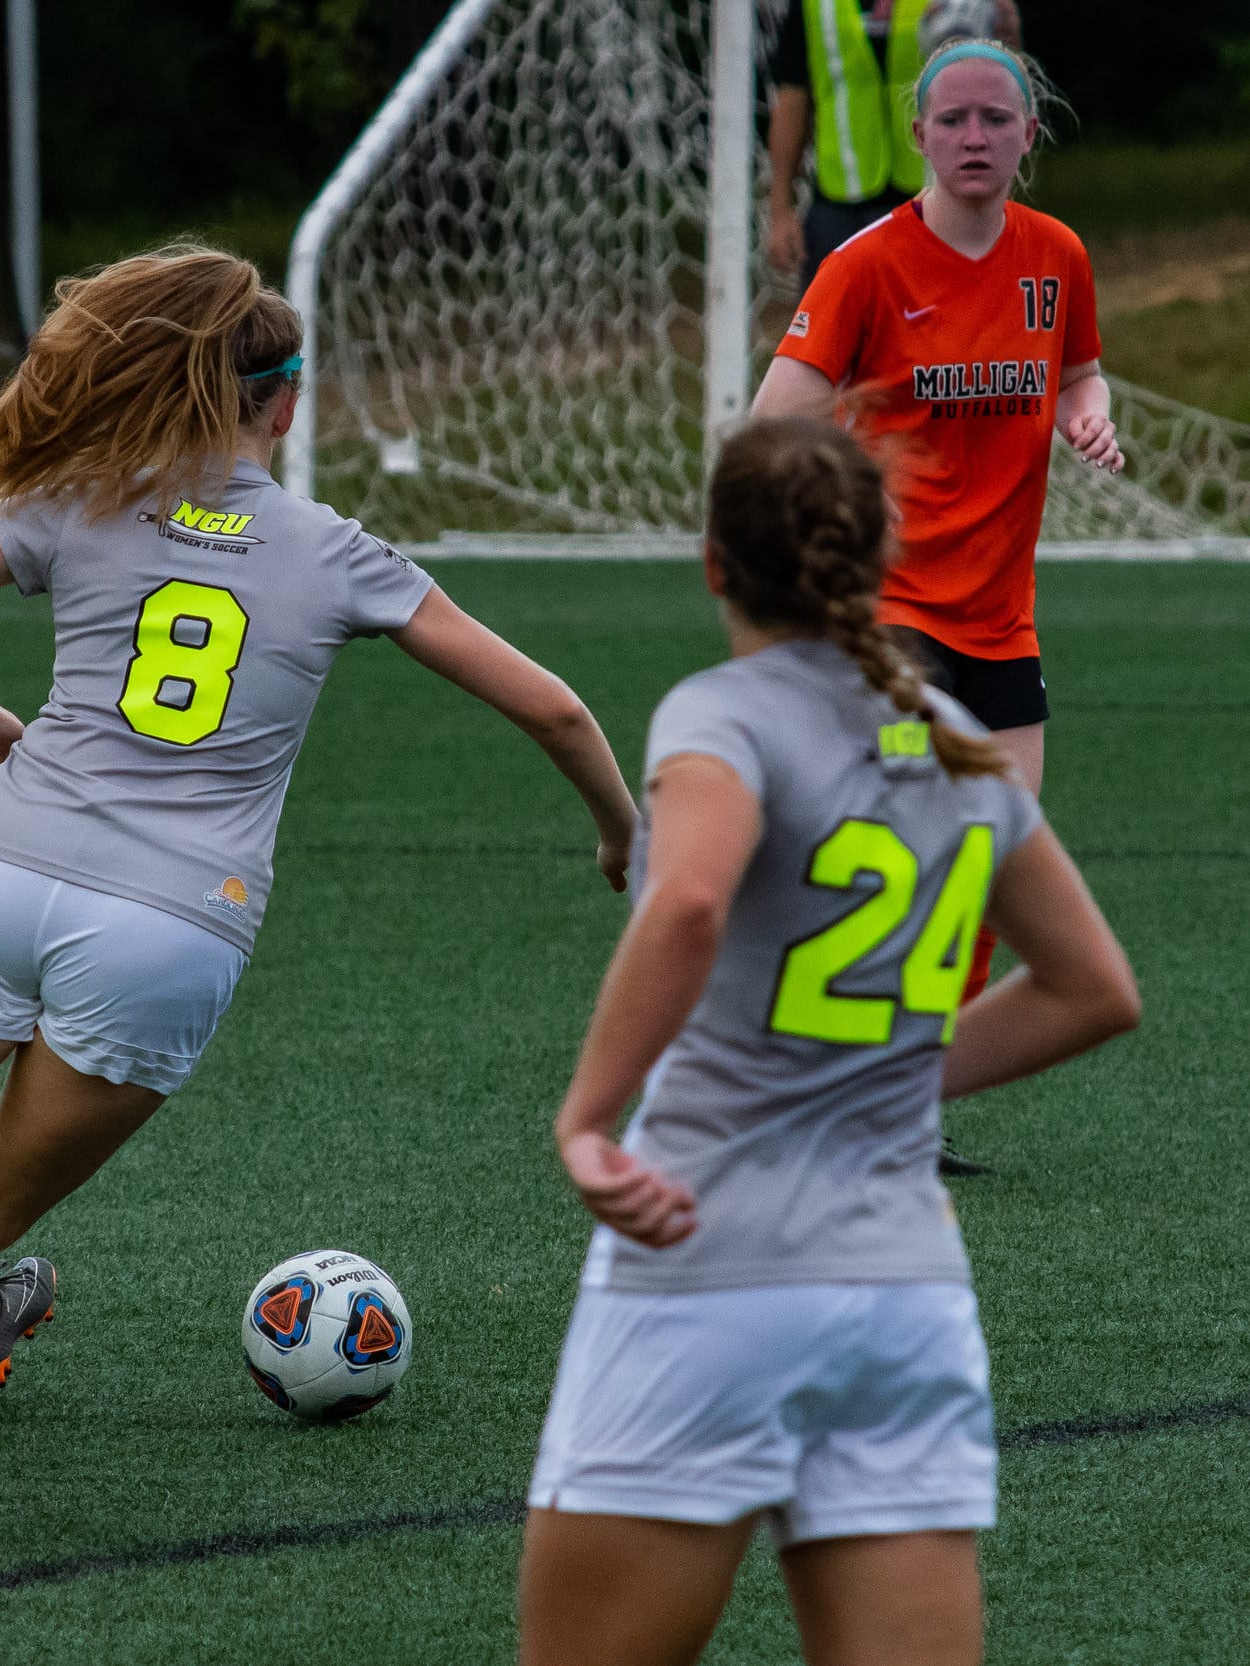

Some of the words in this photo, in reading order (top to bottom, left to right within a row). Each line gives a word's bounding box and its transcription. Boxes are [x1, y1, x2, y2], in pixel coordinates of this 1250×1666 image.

[1018, 276, 1060, 331] 18
[931, 399, 1041, 419] BUFFALOES
[170, 497, 255, 536] NGU
[166, 530, 210, 549] WOMEN'S
[211, 543, 249, 555] SOCCER
[116, 577, 250, 746] 8
[769, 817, 995, 1046] 24
[328, 1270, 379, 1286] Wilson
